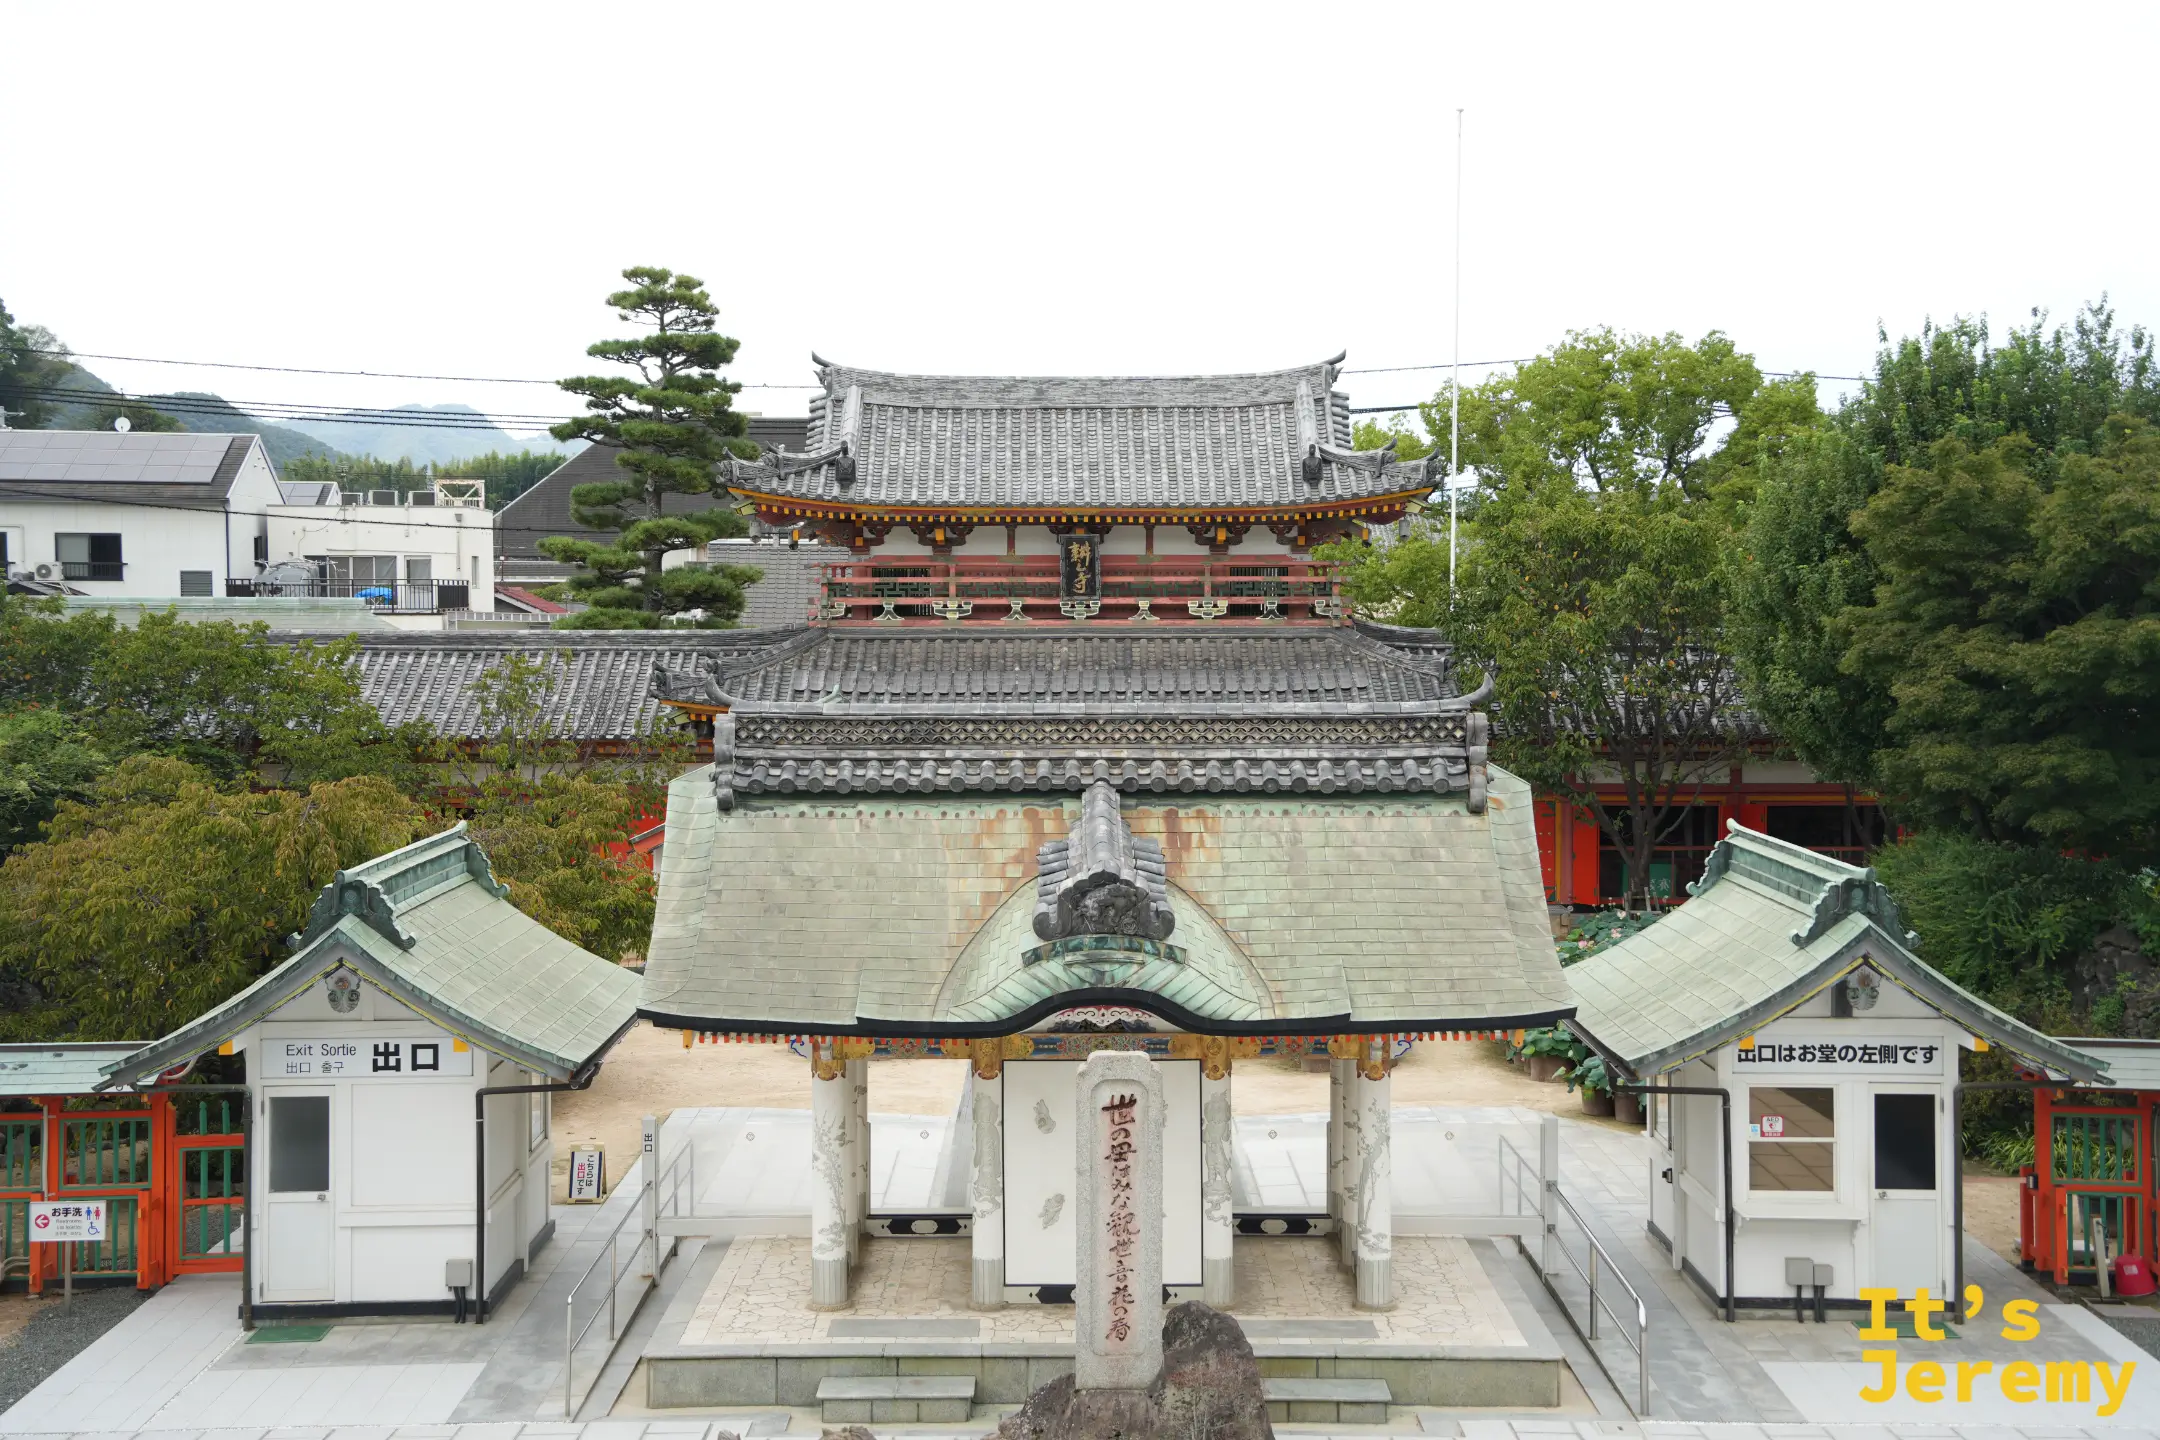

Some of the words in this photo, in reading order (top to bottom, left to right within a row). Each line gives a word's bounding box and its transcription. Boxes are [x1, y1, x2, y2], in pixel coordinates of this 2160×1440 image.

[286, 1044, 313, 1057] Exit
[321, 1043, 357, 1057] Sortie
[372, 1042, 440, 1073] 出口
[1737, 1044, 1939, 1064] 出口はお堂の左側です
[286, 1061, 311, 1074] 出口
[321, 1061, 345, 1074] 출구
[644, 1132, 653, 1153] 出口
[576, 1162, 586, 1196] 出口です
[585, 1154, 595, 1187] こちらは
[51, 1206, 83, 1218] お手洗
